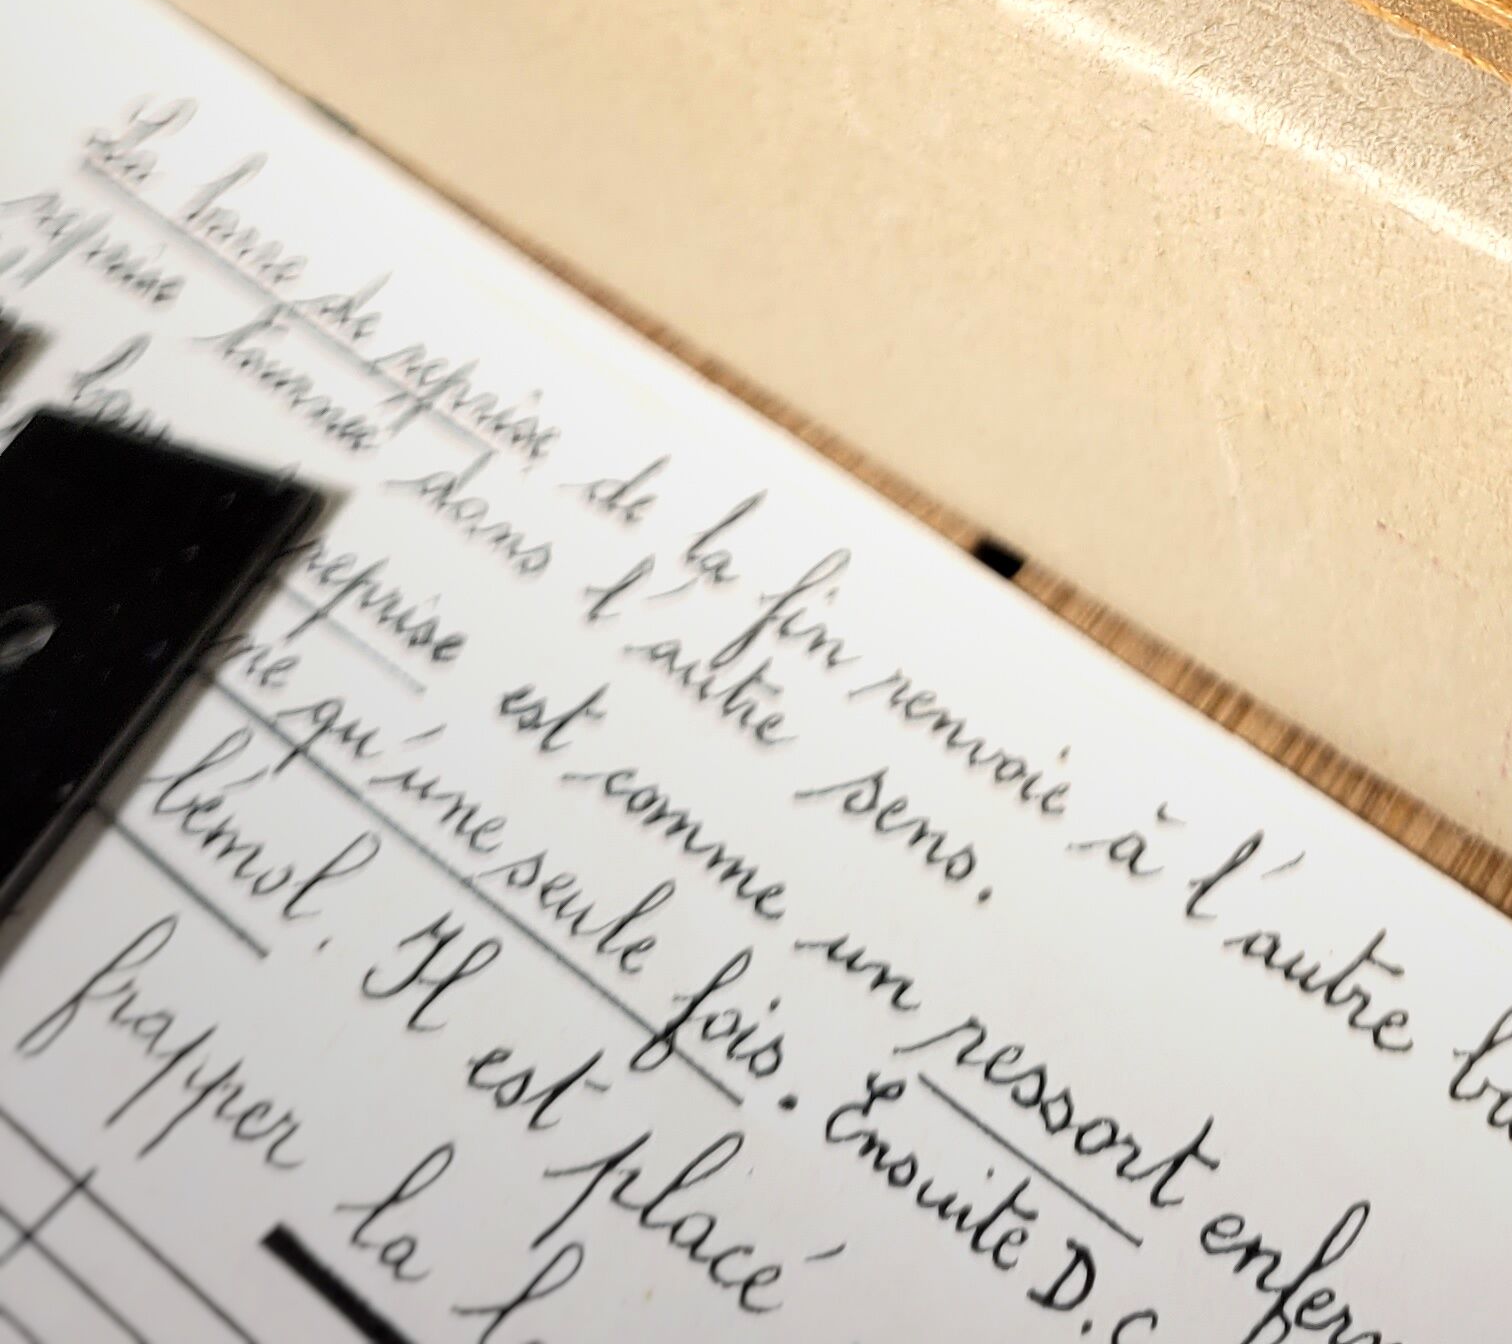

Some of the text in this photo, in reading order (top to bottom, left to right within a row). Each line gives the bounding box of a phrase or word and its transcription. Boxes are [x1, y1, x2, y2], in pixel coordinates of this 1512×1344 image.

[290, 271, 394, 342] de
[370, 343, 561, 462] reprise
[380, 448, 554, 577] dans
[557, 454, 672, 524] de
[684, 489, 768, 585] la
[708, 548, 862, 670] fin
[848, 669, 1068, 815] renvoie
[498, 683, 608, 752] est
[561, 767, 788, 920] comme
[795, 933, 922, 1012] un
[892, 1015, 1222, 1208] ressort
[14, 912, 457, 1282] frapper la
[464, 1046, 613, 1131] est
[484, 849, 677, 975] seule
[824, 1069, 1041, 1271] Ensuite
[532, 1130, 846, 1315] placé
